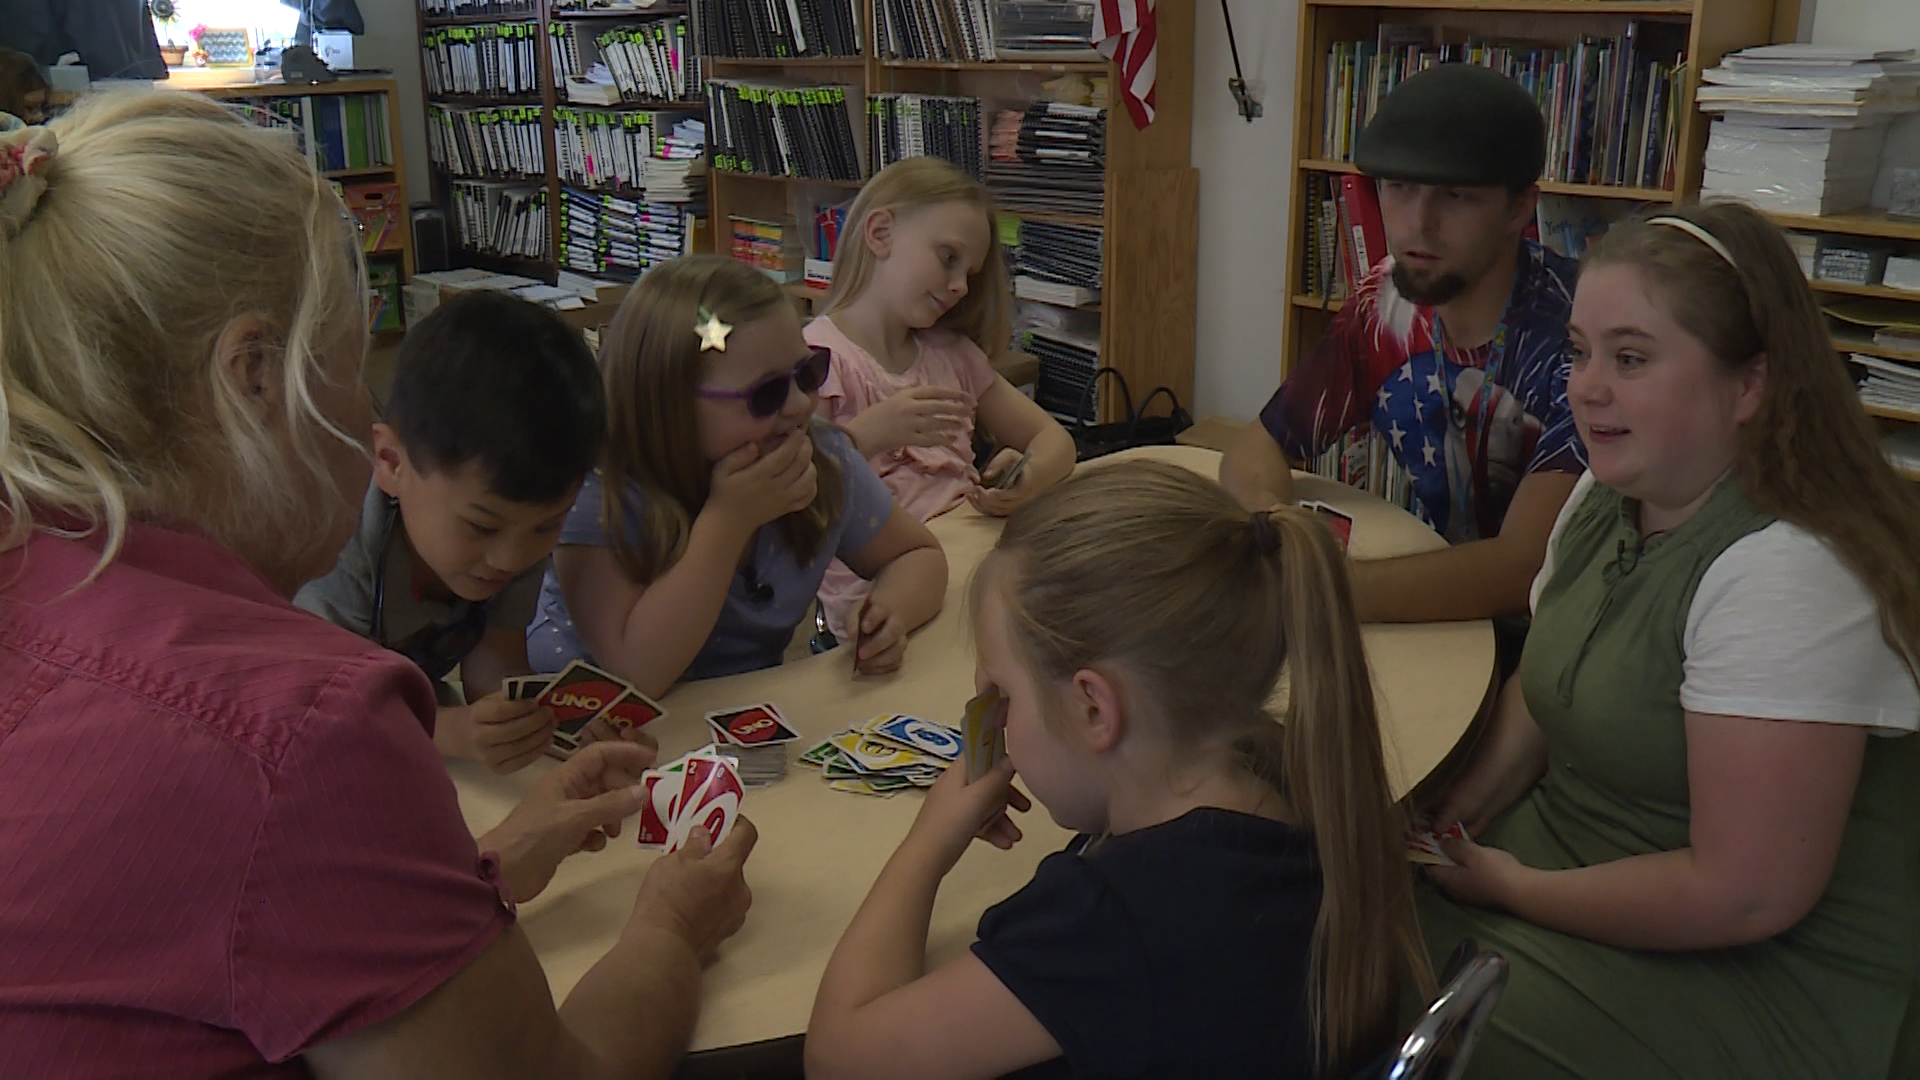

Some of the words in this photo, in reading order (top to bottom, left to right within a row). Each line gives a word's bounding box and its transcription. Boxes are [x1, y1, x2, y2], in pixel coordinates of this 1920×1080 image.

[551, 692, 602, 711] UNO
[732, 719, 775, 735] UNO
[688, 761, 698, 774] 2
